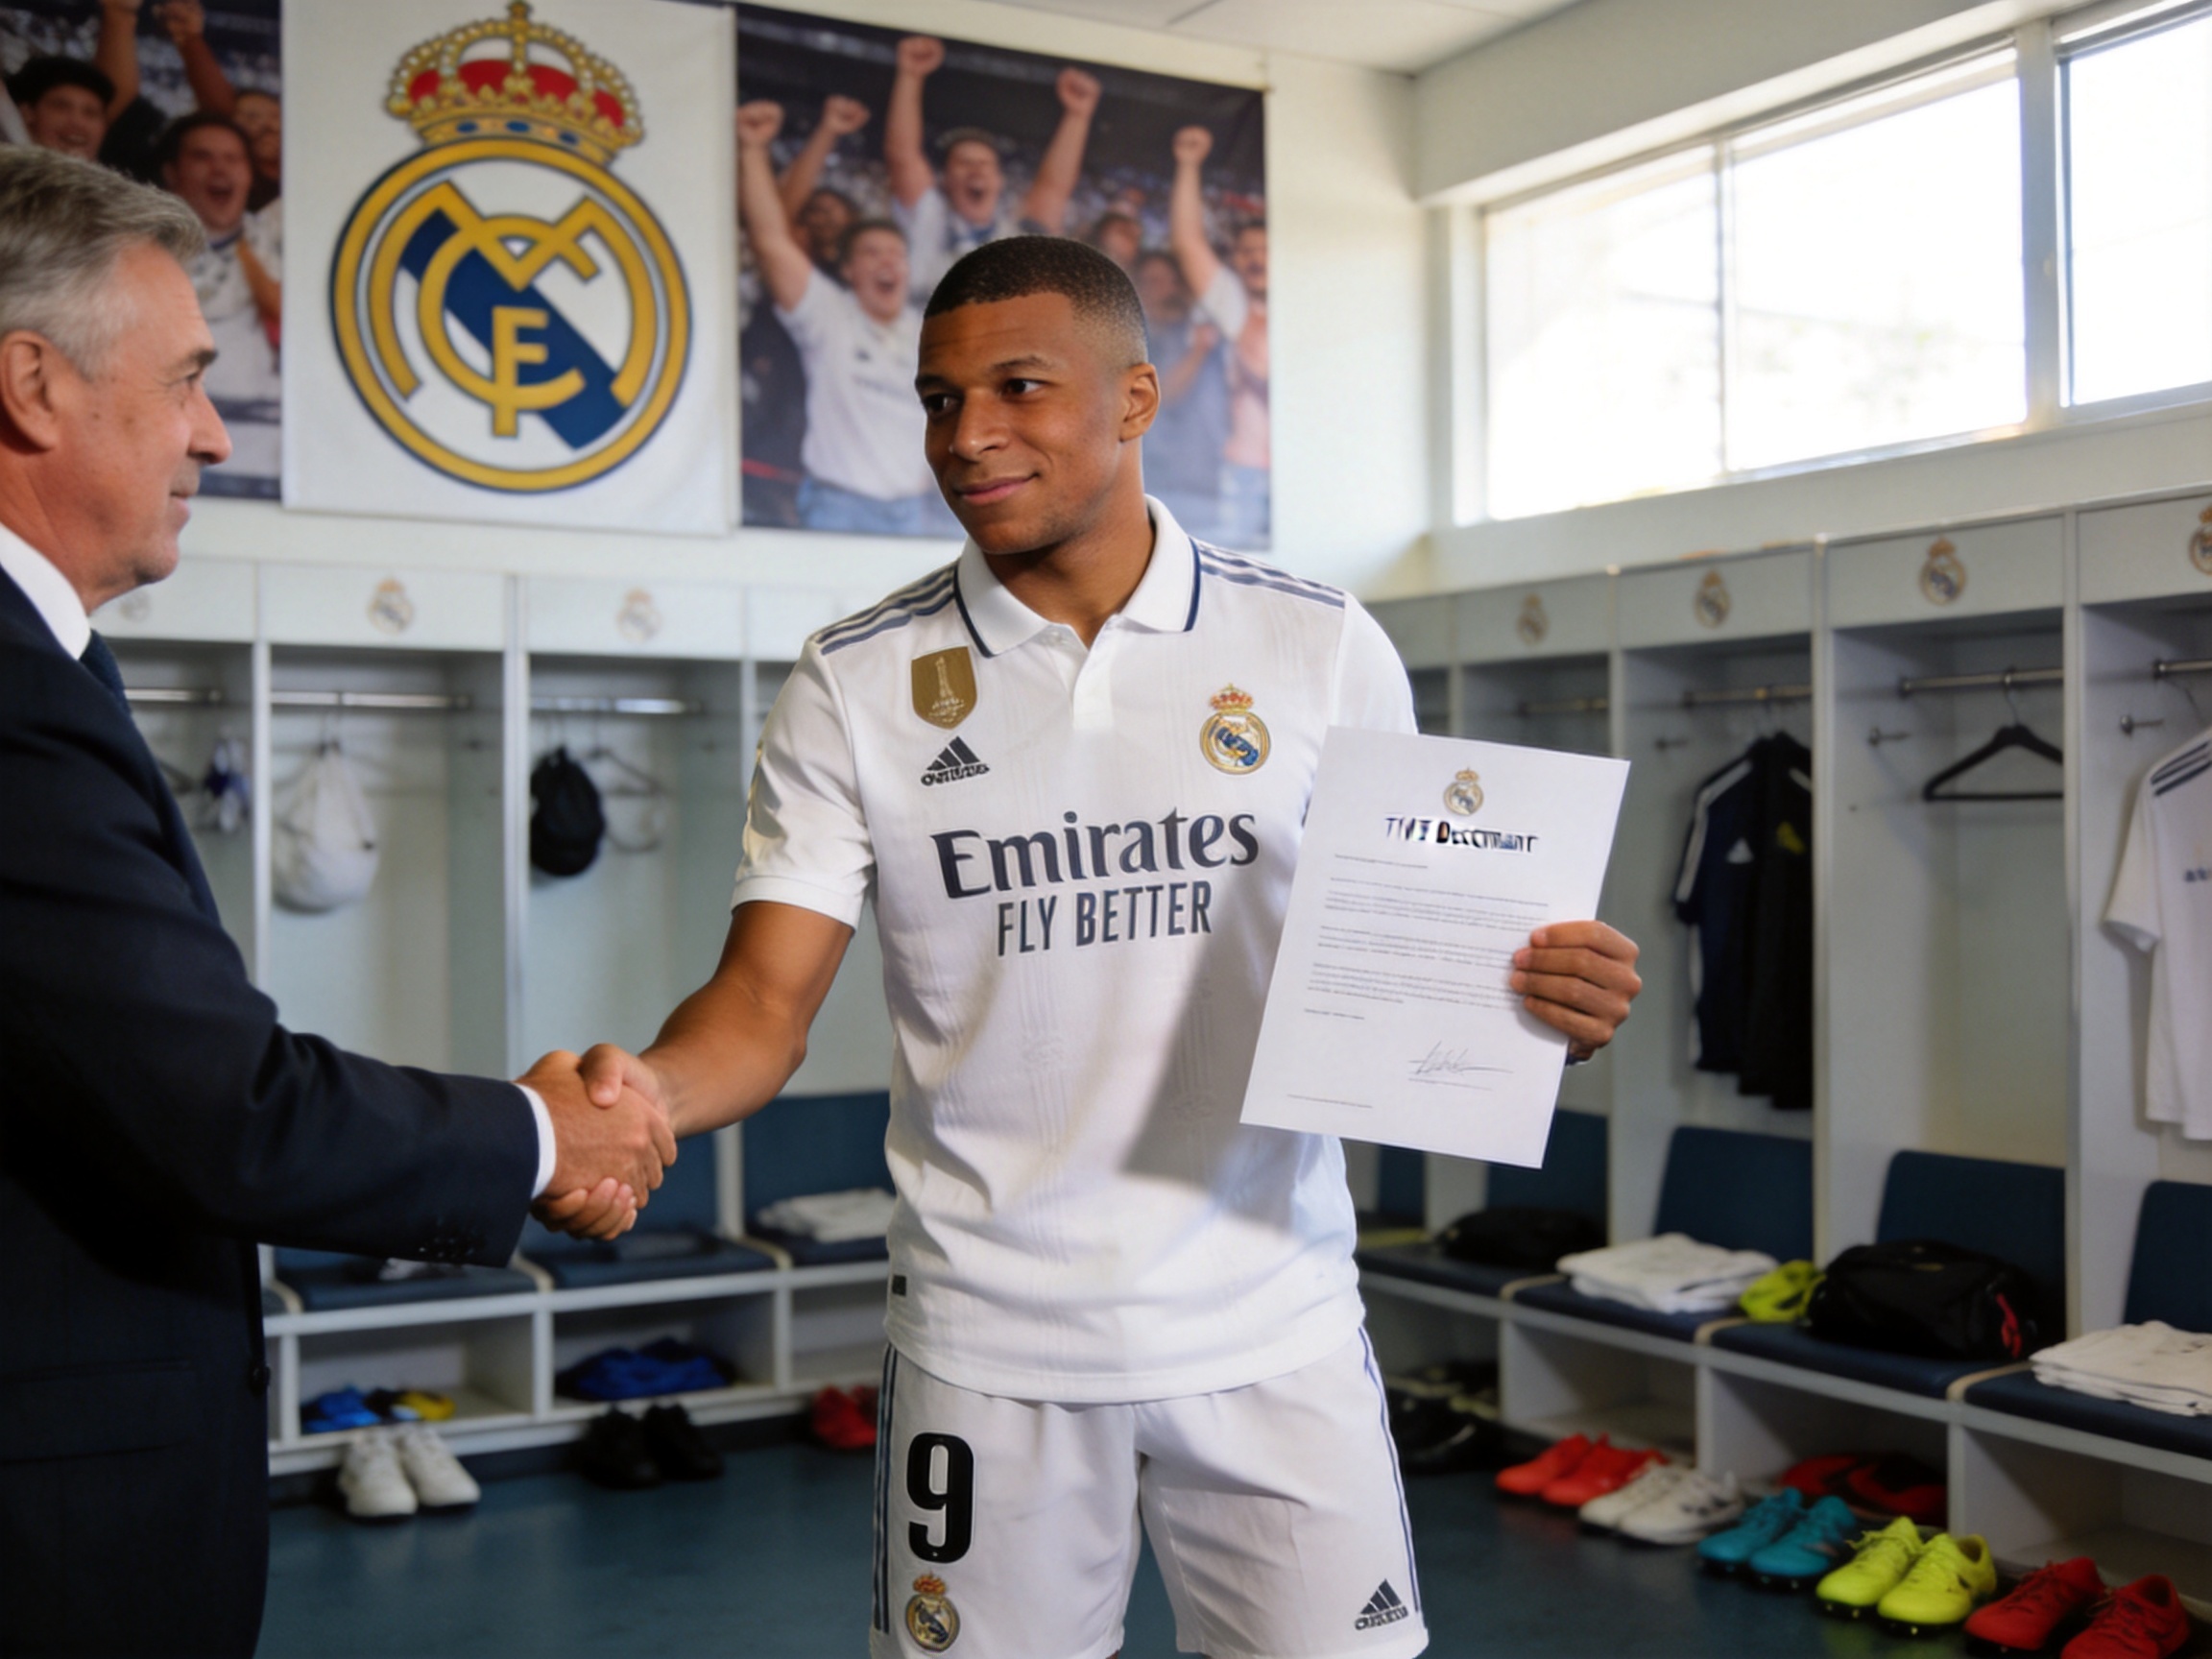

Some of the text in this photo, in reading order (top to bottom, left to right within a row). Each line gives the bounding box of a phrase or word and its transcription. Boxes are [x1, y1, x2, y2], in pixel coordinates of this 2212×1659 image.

[929, 806, 1260, 900] Emirates
[998, 880, 1212, 957] FLY BETTER
[906, 1432, 974, 1564] 9
